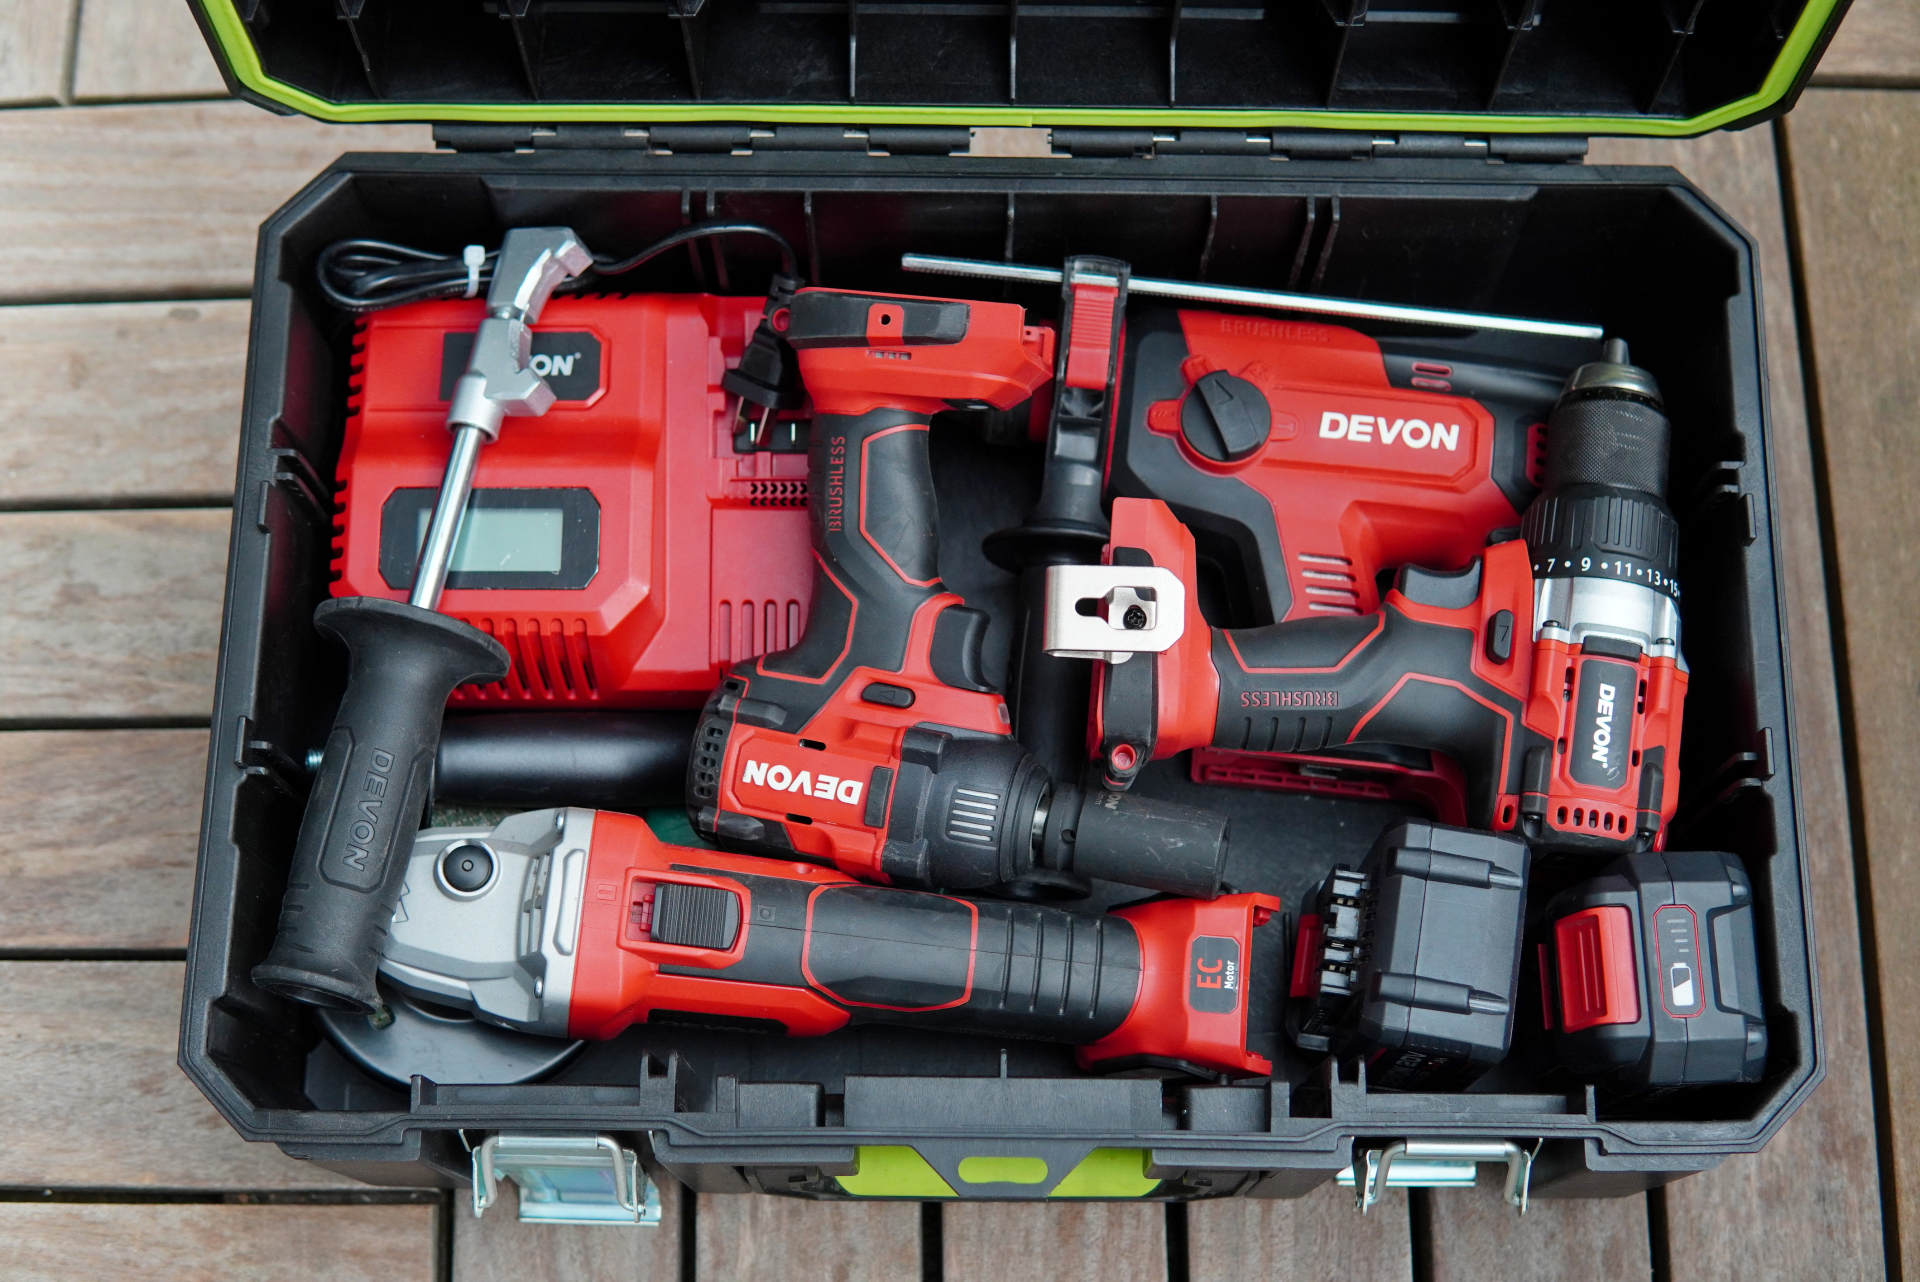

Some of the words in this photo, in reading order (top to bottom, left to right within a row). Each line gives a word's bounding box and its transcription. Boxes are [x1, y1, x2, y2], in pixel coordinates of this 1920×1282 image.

[1319, 411, 1460, 451] DEVON
[828, 436, 846, 532] BRUSHLESS
[1547, 558, 1556, 573] 7
[1581, 557, 1591, 572] 9
[1614, 560, 1632, 577] 11
[1647, 568, 1661, 586] 13
[1240, 691, 1339, 707] BRUSHLESS
[1591, 682, 1616, 763] DEVON
[742, 759, 864, 806] DEVON
[343, 747, 395, 872] DEVON
[1197, 957, 1223, 989] EC
[1223, 960, 1235, 990] Motor
